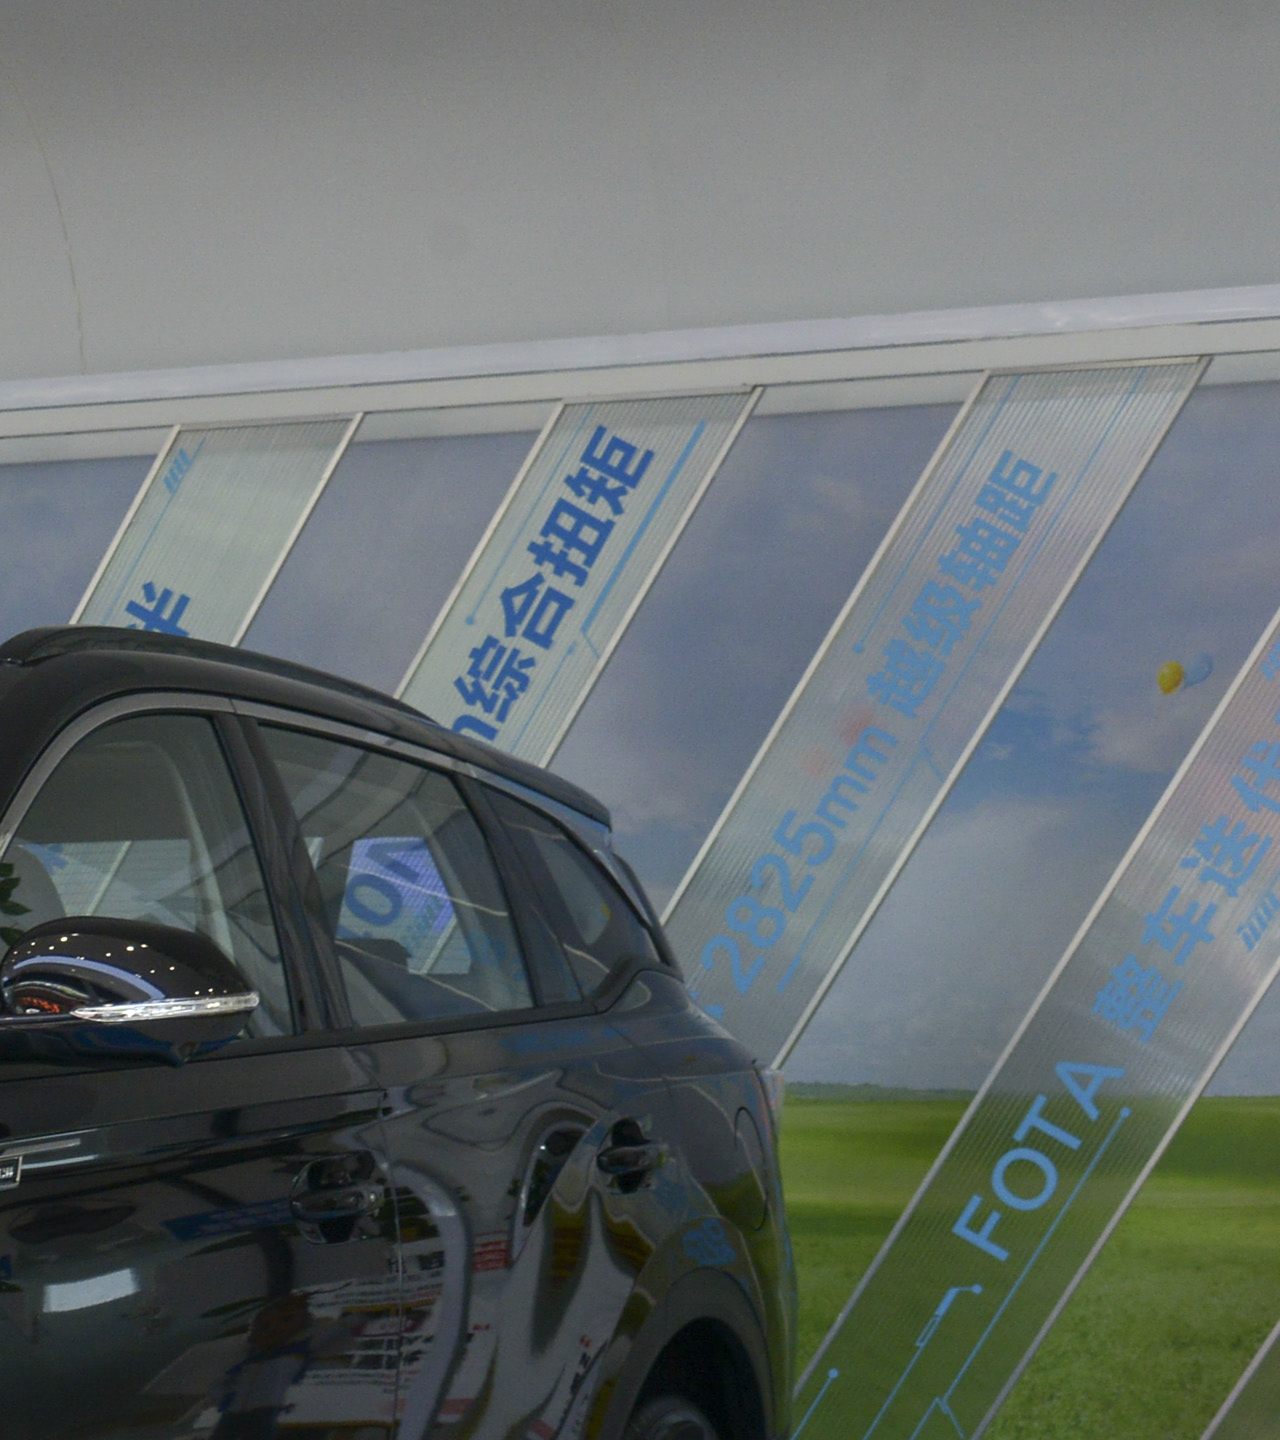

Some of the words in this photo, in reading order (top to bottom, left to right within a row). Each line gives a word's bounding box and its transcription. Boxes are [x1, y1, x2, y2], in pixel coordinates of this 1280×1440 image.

[865, 449, 1057, 719] 越级轴距
[951, 1057, 1125, 1263] FOTA
